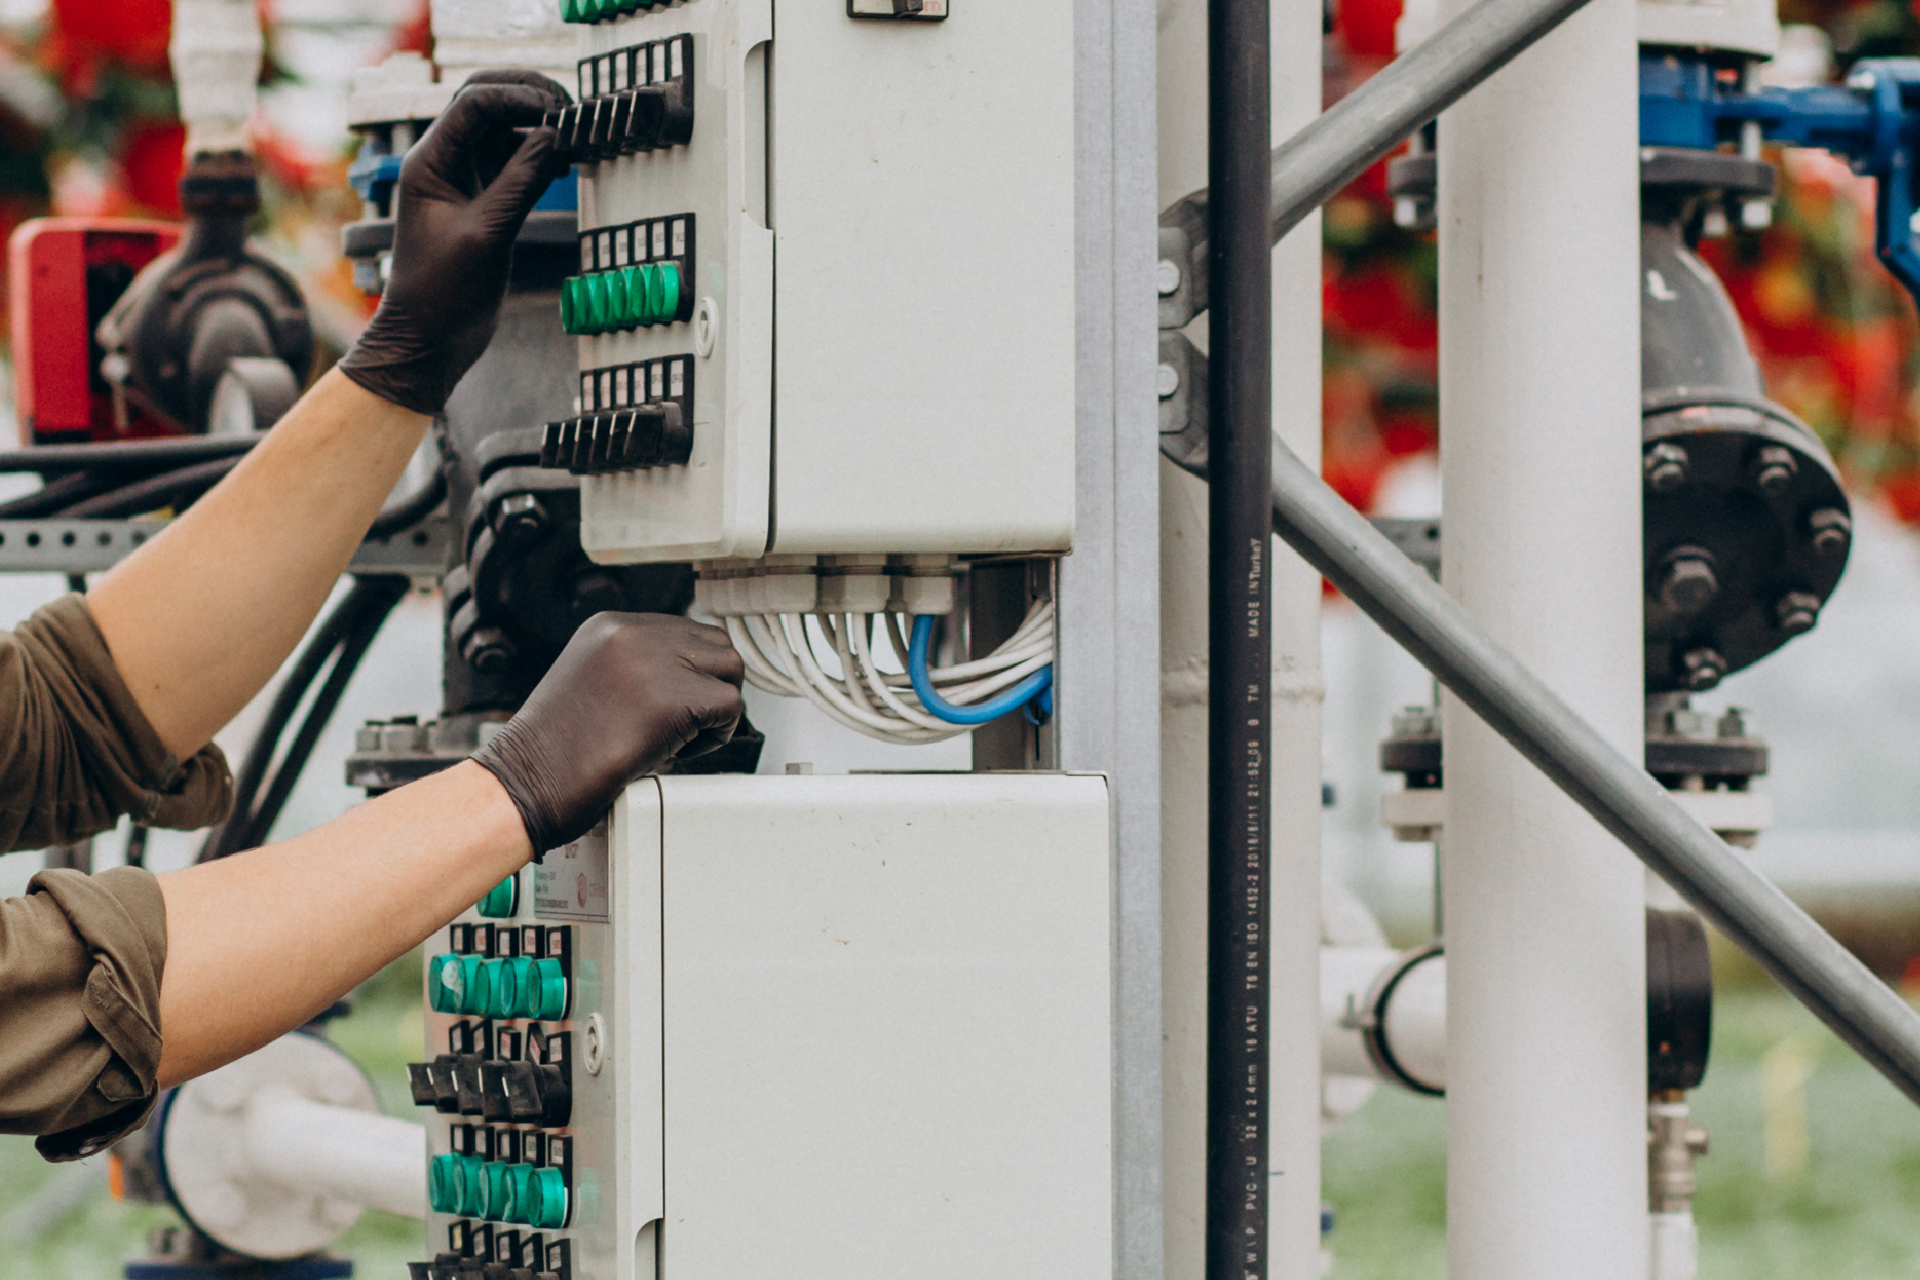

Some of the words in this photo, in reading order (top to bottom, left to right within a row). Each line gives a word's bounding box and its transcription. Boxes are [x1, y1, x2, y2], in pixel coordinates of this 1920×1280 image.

[1247, 601, 1259, 638] MADE
[1247, 684, 1259, 702] TM
[1246, 923, 1258, 946] ISO
[1246, 951, 1258, 968] EN
[1246, 974, 1258, 991] TS
[1246, 1005, 1258, 1032] ATU
